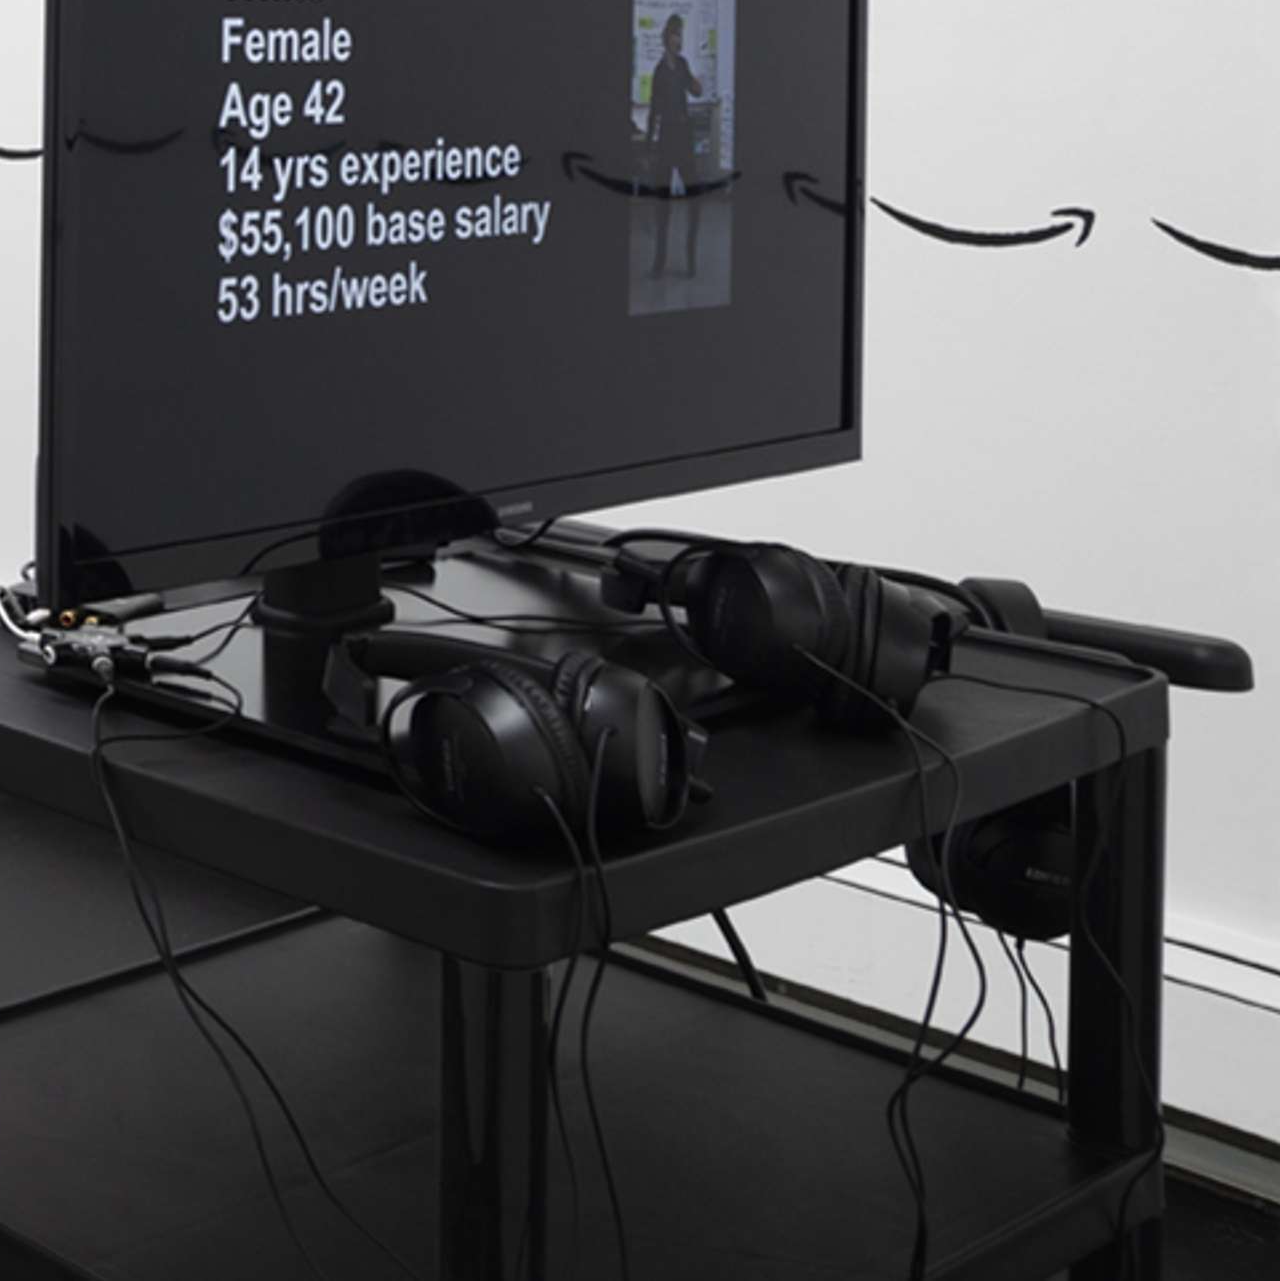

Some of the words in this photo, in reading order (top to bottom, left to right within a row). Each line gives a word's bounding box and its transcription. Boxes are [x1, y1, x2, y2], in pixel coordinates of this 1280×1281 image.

[221, 17, 352, 63] Female
[219, 82, 293, 140] Age
[303, 79, 345, 124] 42
[220, 145, 263, 193] 14
[273, 154, 329, 203] yrs
[340, 138, 521, 194] experience
[218, 204, 355, 262] $55,100
[367, 202, 446, 246] base
[455, 195, 551, 244] salary
[217, 274, 260, 323] 53
[272, 261, 427, 317] hrs/week
